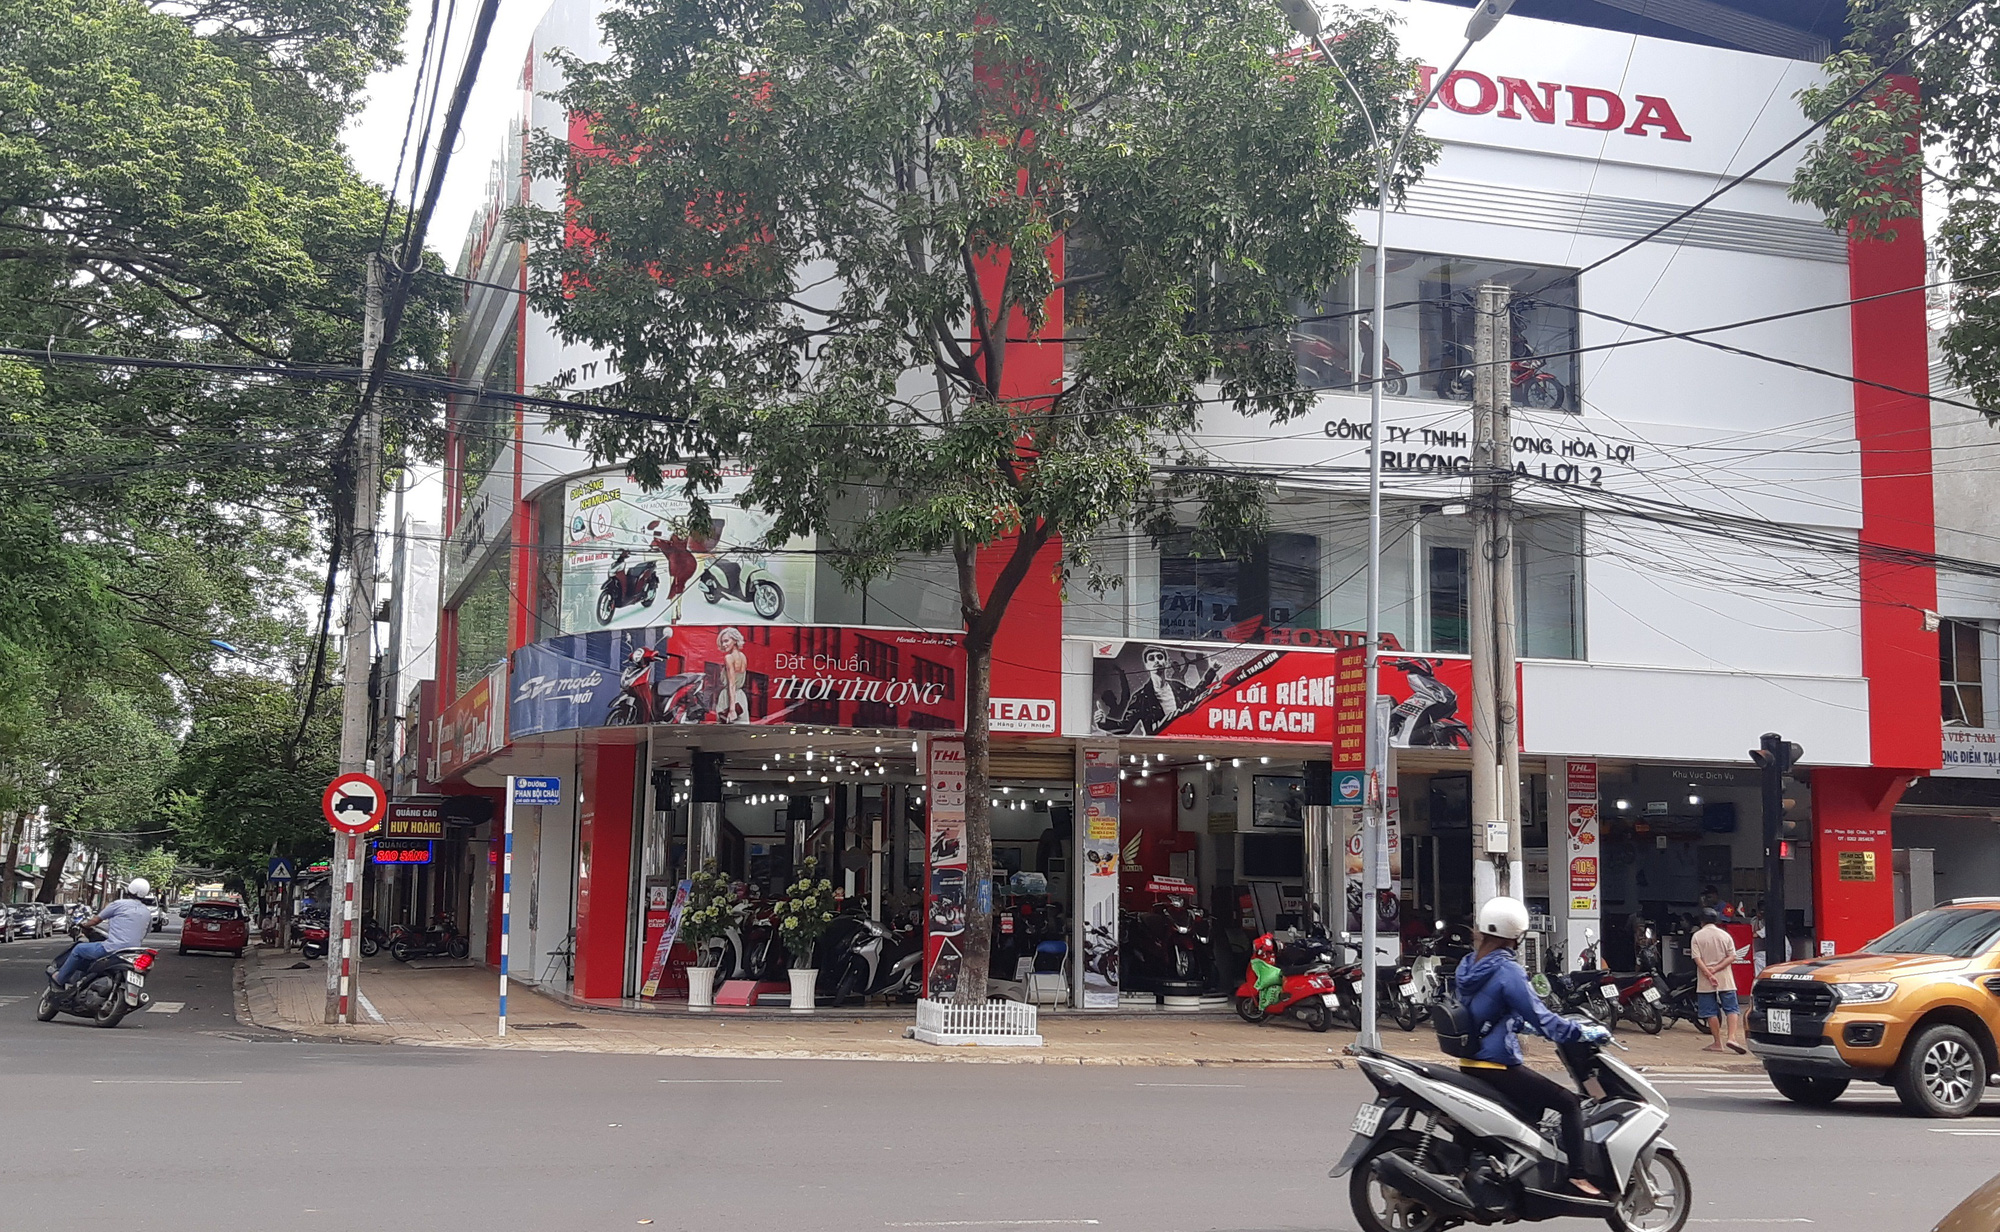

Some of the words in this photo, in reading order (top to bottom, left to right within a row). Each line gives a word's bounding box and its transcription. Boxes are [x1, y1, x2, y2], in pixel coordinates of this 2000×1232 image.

[581, 360, 598, 381] TY
[1324, 418, 1373, 441] CÔNG
[1386, 425, 1411, 444] TY
[1420, 428, 1467, 448] TNHH
[1561, 436, 1598, 459] HÒA
[1606, 443, 1635, 466] LỢI
[1589, 465, 1603, 487] 2
[774, 654, 806, 673] Đặt
[813, 653, 871, 673] Chuẩn
[772, 671, 834, 701] THỜI
[835, 675, 946, 709] THƯỢNG
[1235, 682, 1267, 704] LỐI
[1276, 676, 1335, 707] RIÊNG
[1208, 706, 1254, 731] PHÁ
[1258, 707, 1316, 734] CÁCH
[1948, 730, 1971, 743] VIỆT
[1974, 733, 1996, 743] NAM
[1960, 745, 1981, 764] ĐIỂM
[1570, 763, 1591, 772] THL
[1672, 770, 1688, 779] Khu
[515, 789, 531, 798] PHAN
[543, 788, 559, 798] CHÂU
[395, 807, 421, 817] QUẢNG
[422, 808, 438, 818] CÁO
[390, 820, 409, 833] HUY
[410, 819, 441, 834] HOÀNG
[376, 850, 399, 862] SAO
[399, 848, 430, 862] SÁNG
